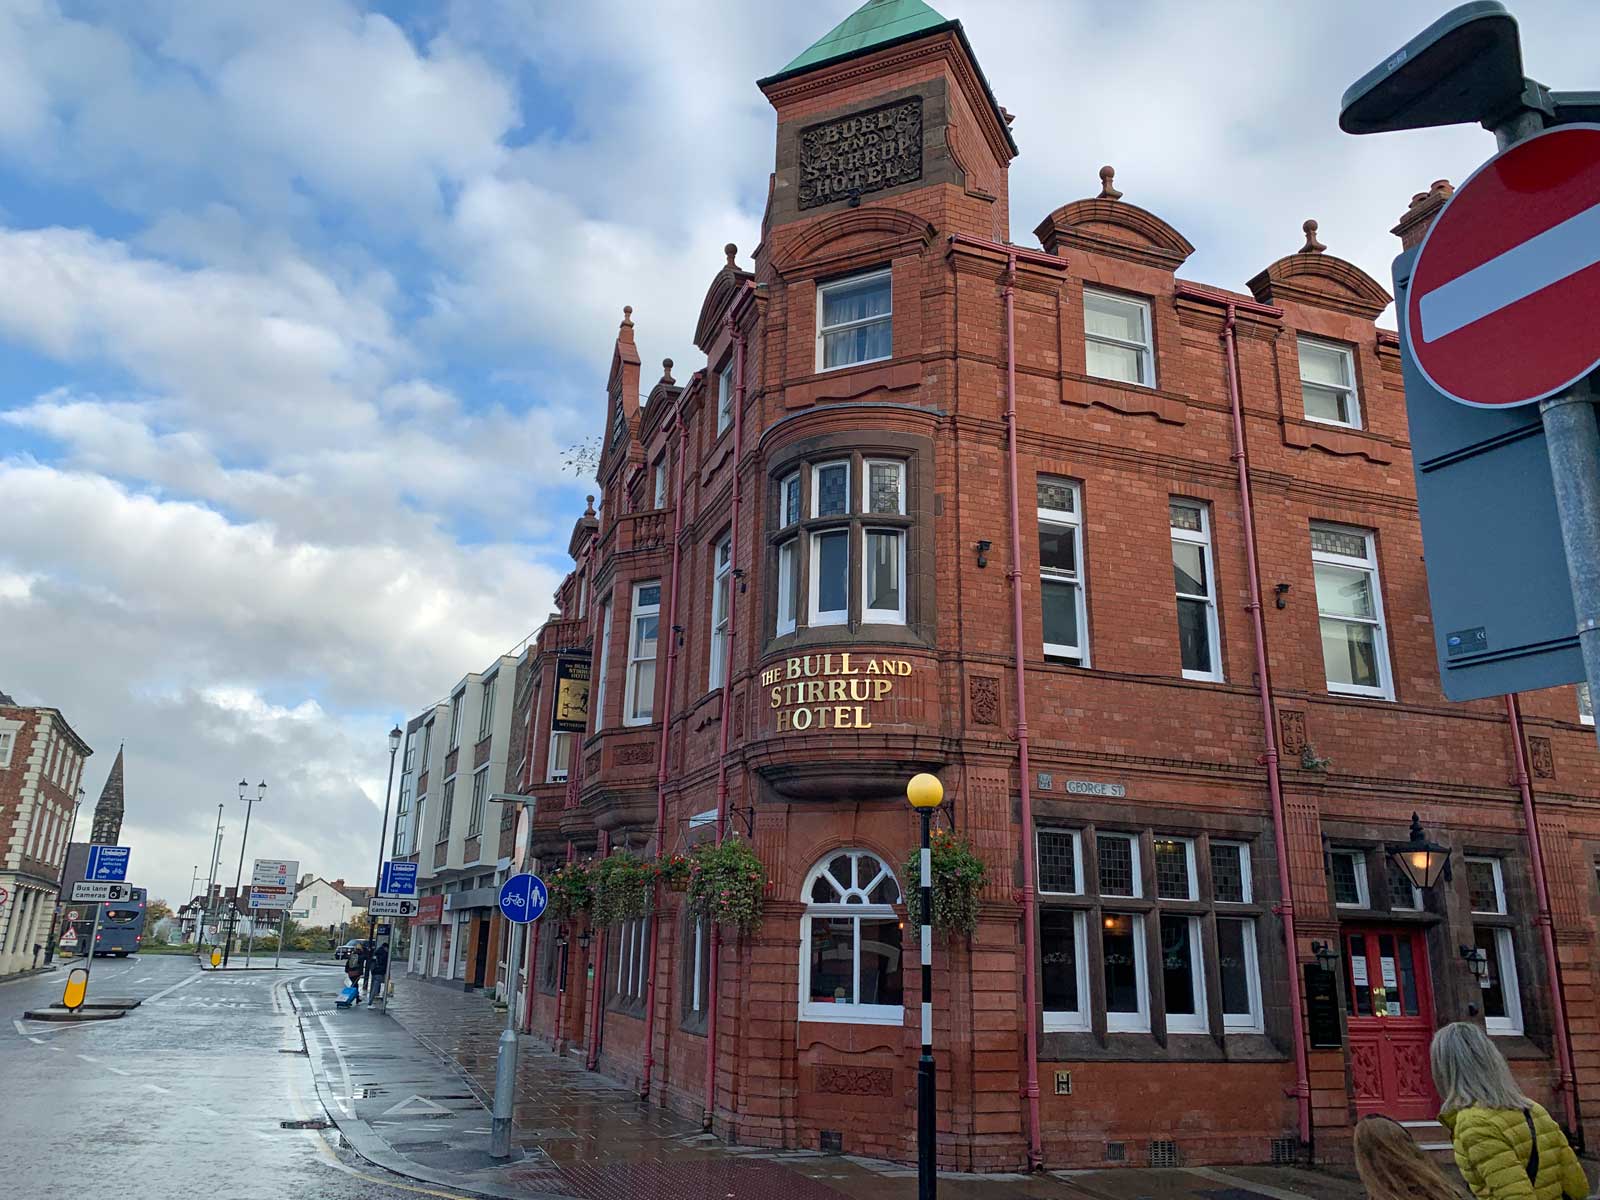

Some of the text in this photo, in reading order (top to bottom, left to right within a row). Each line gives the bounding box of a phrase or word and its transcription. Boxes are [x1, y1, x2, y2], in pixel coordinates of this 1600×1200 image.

[823, 112, 896, 143] BULL
[802, 136, 911, 180] STIRRUP
[839, 133, 881, 154] AND
[816, 161, 902, 197] HOTEL
[761, 653, 912, 687] THE BULL AND
[770, 678, 893, 709] STIRRUP
[776, 706, 872, 732] HOTEL
[1068, 781, 1123, 796] GEORGE ST
